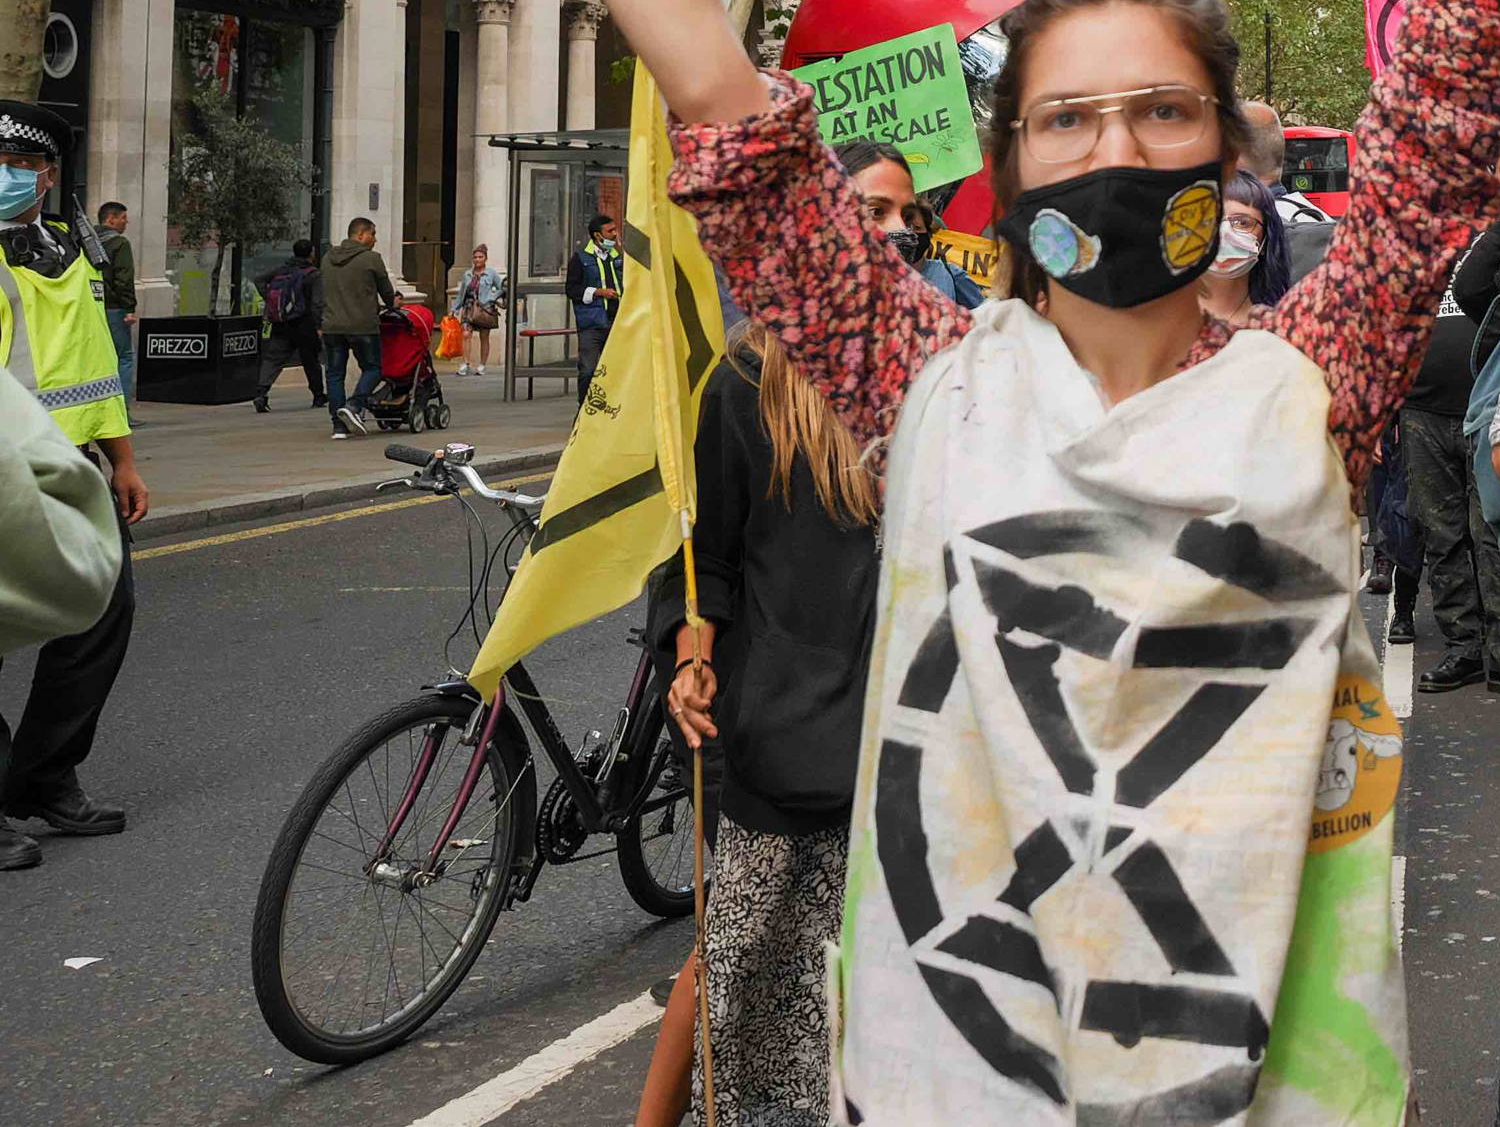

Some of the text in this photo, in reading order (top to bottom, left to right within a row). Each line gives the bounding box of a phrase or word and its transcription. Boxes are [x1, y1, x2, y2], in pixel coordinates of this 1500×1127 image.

[831, 110, 858, 140] AT
[866, 98, 899, 129] AN
[880, 107, 952, 145] SCALE
[150, 334, 256, 354] PREZZO PREZZO
